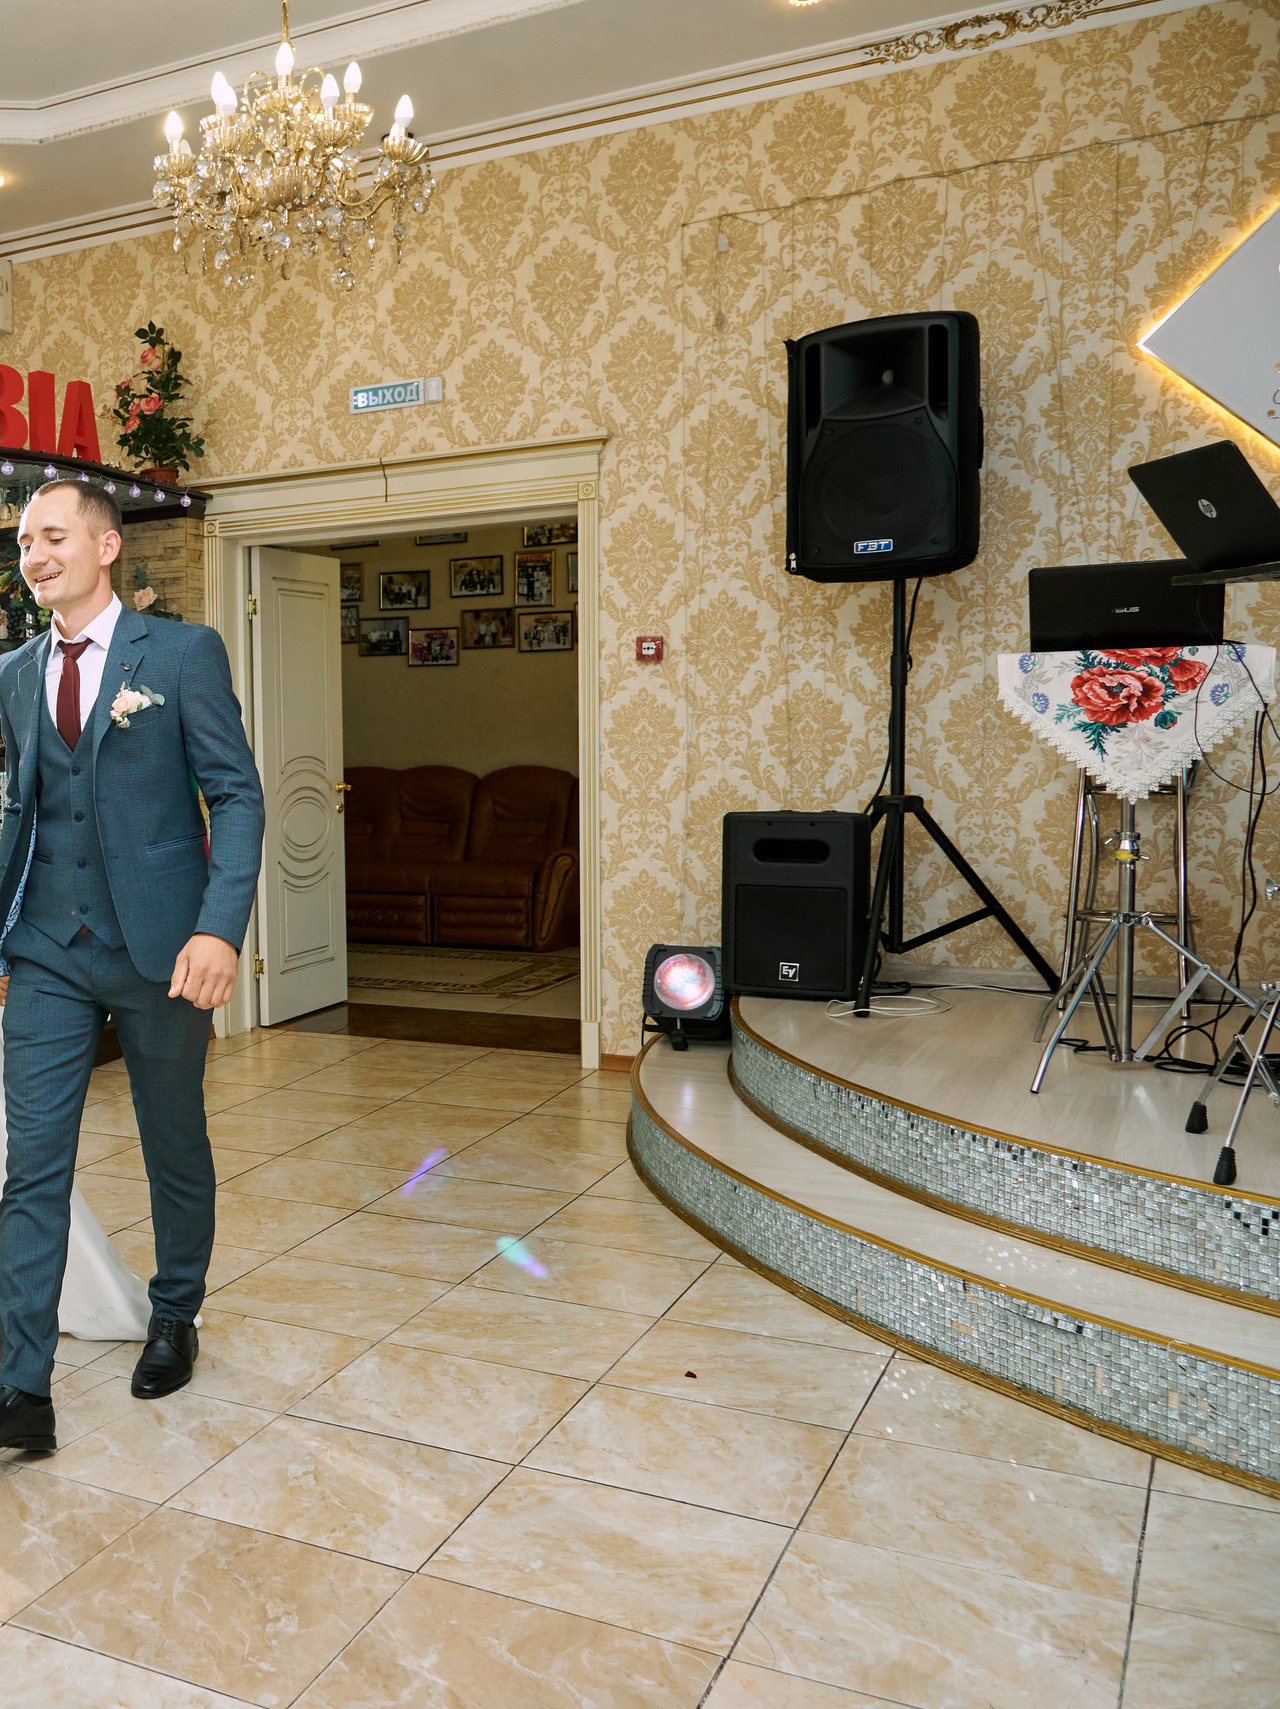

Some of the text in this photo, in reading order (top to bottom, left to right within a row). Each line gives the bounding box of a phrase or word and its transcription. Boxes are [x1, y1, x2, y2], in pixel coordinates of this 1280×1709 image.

[357, 385, 418, 408] ВЫХОД
[1200, 499, 1214, 518] hp
[857, 541, 889, 552] FBT
[782, 965, 797, 978] EV
